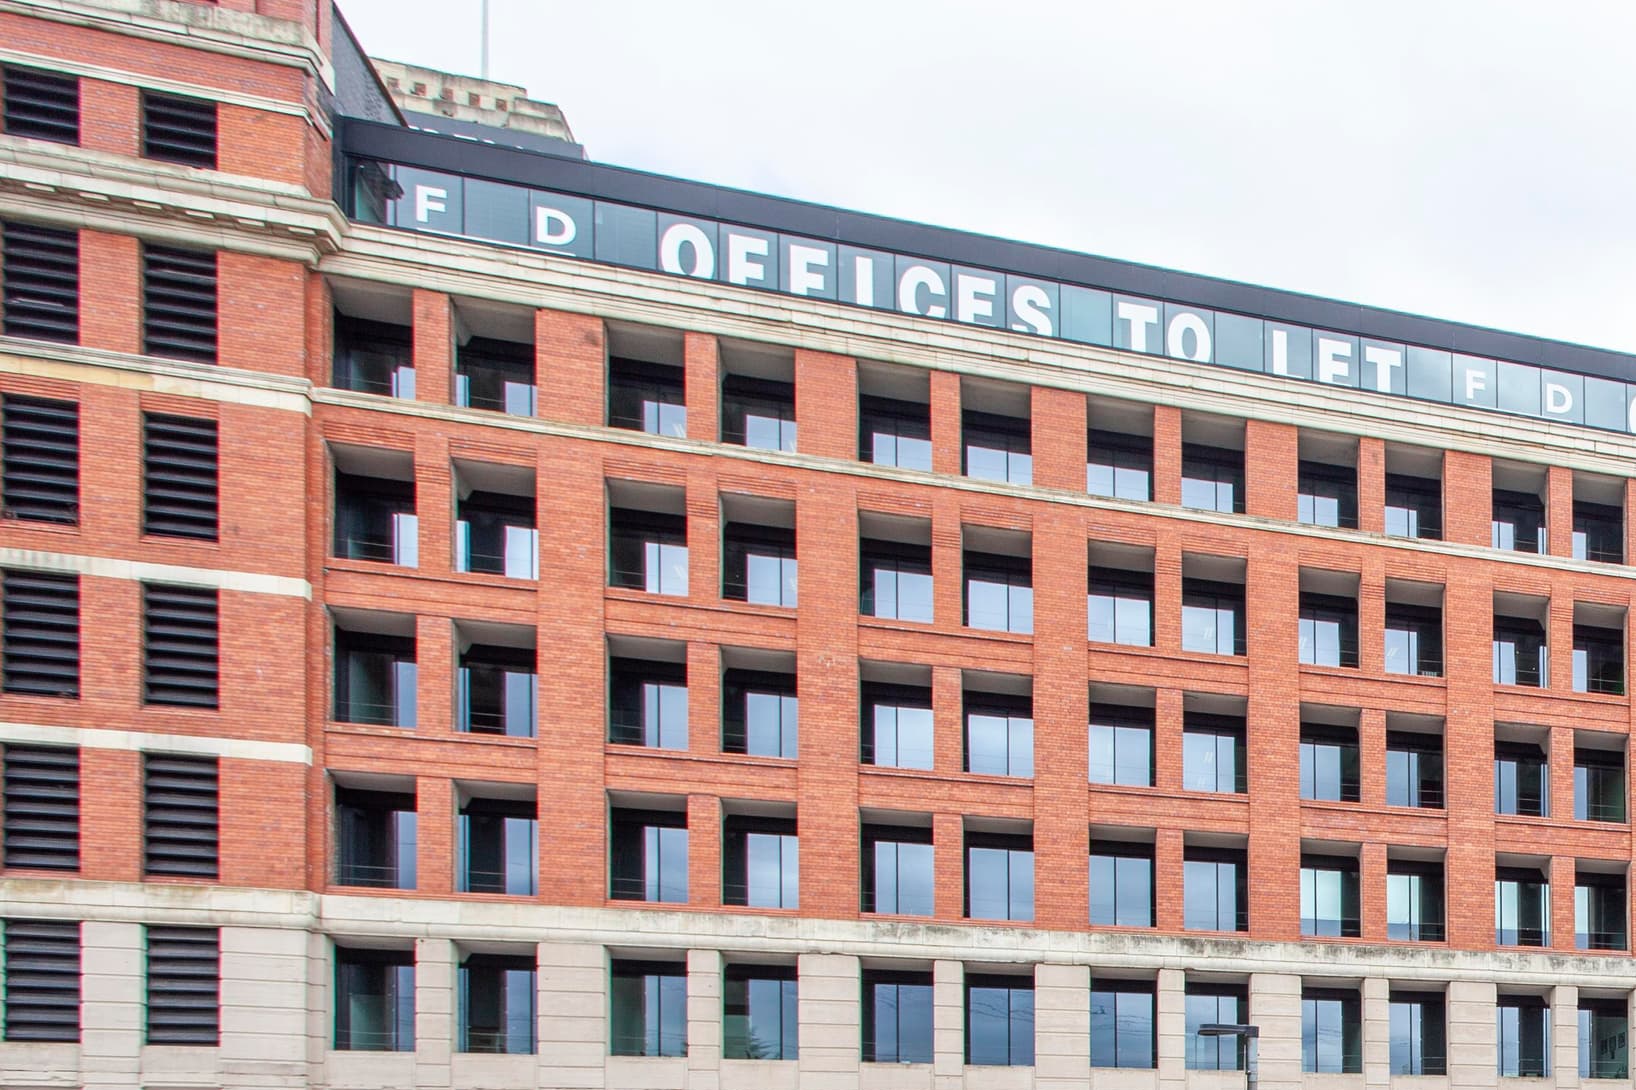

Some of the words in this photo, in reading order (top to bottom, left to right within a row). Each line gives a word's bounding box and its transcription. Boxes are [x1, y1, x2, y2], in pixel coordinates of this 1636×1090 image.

[415, 184, 447, 223] F
[536, 207, 576, 246] D
[658, 222, 1054, 339] OFFICES
[1117, 301, 1212, 364] TO
[1465, 369, 1486, 400] F
[1546, 384, 1573, 414] D
